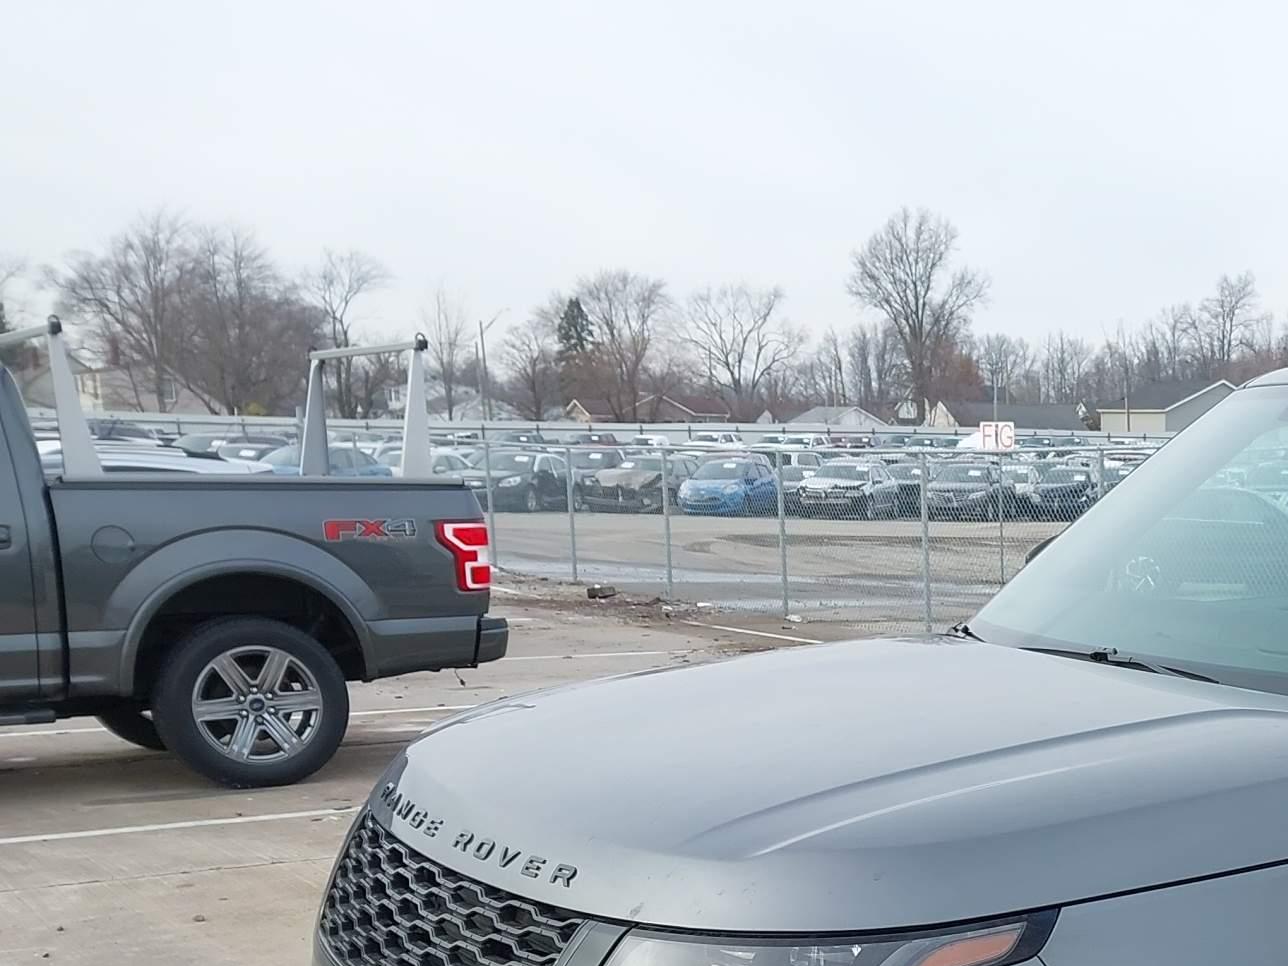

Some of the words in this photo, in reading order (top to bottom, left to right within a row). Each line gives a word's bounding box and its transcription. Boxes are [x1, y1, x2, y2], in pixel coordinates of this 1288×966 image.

[322, 518, 417, 541] FX4
[380, 781, 444, 838] RANGE
[452, 829, 579, 888] ROVER
